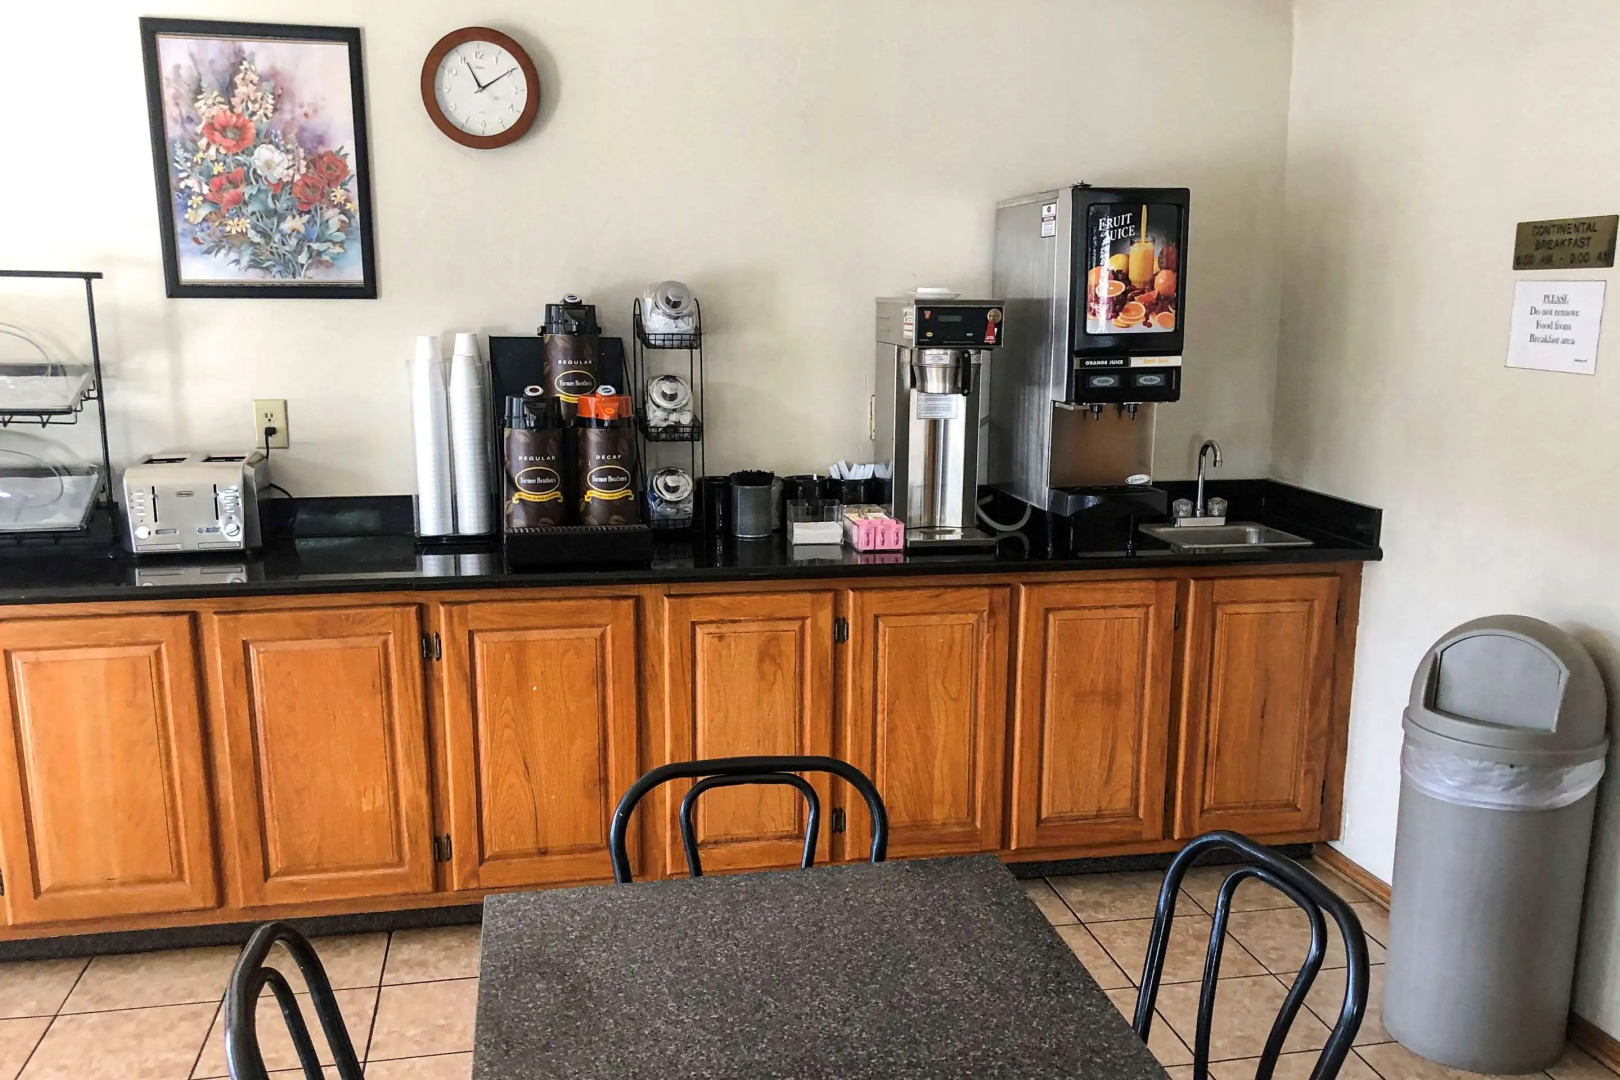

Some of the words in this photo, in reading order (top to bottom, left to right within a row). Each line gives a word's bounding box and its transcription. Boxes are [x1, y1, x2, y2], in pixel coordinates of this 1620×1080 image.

[460, 55, 466, 64] 11
[474, 51, 484, 59] 12
[1098, 213, 1132, 231] FRUIT
[1532, 221, 1598, 236] CONTINENTAL
[1535, 236, 1592, 251] BREAKFAST
[1543, 293, 1569, 304] PLEASE
[1530, 306, 1541, 316] Do
[1554, 309, 1580, 317] remove
[1536, 320, 1554, 330] Food
[1554, 320, 1572, 331] from
[1529, 333, 1560, 345] Breakfast
[1560, 337, 1576, 346] area
